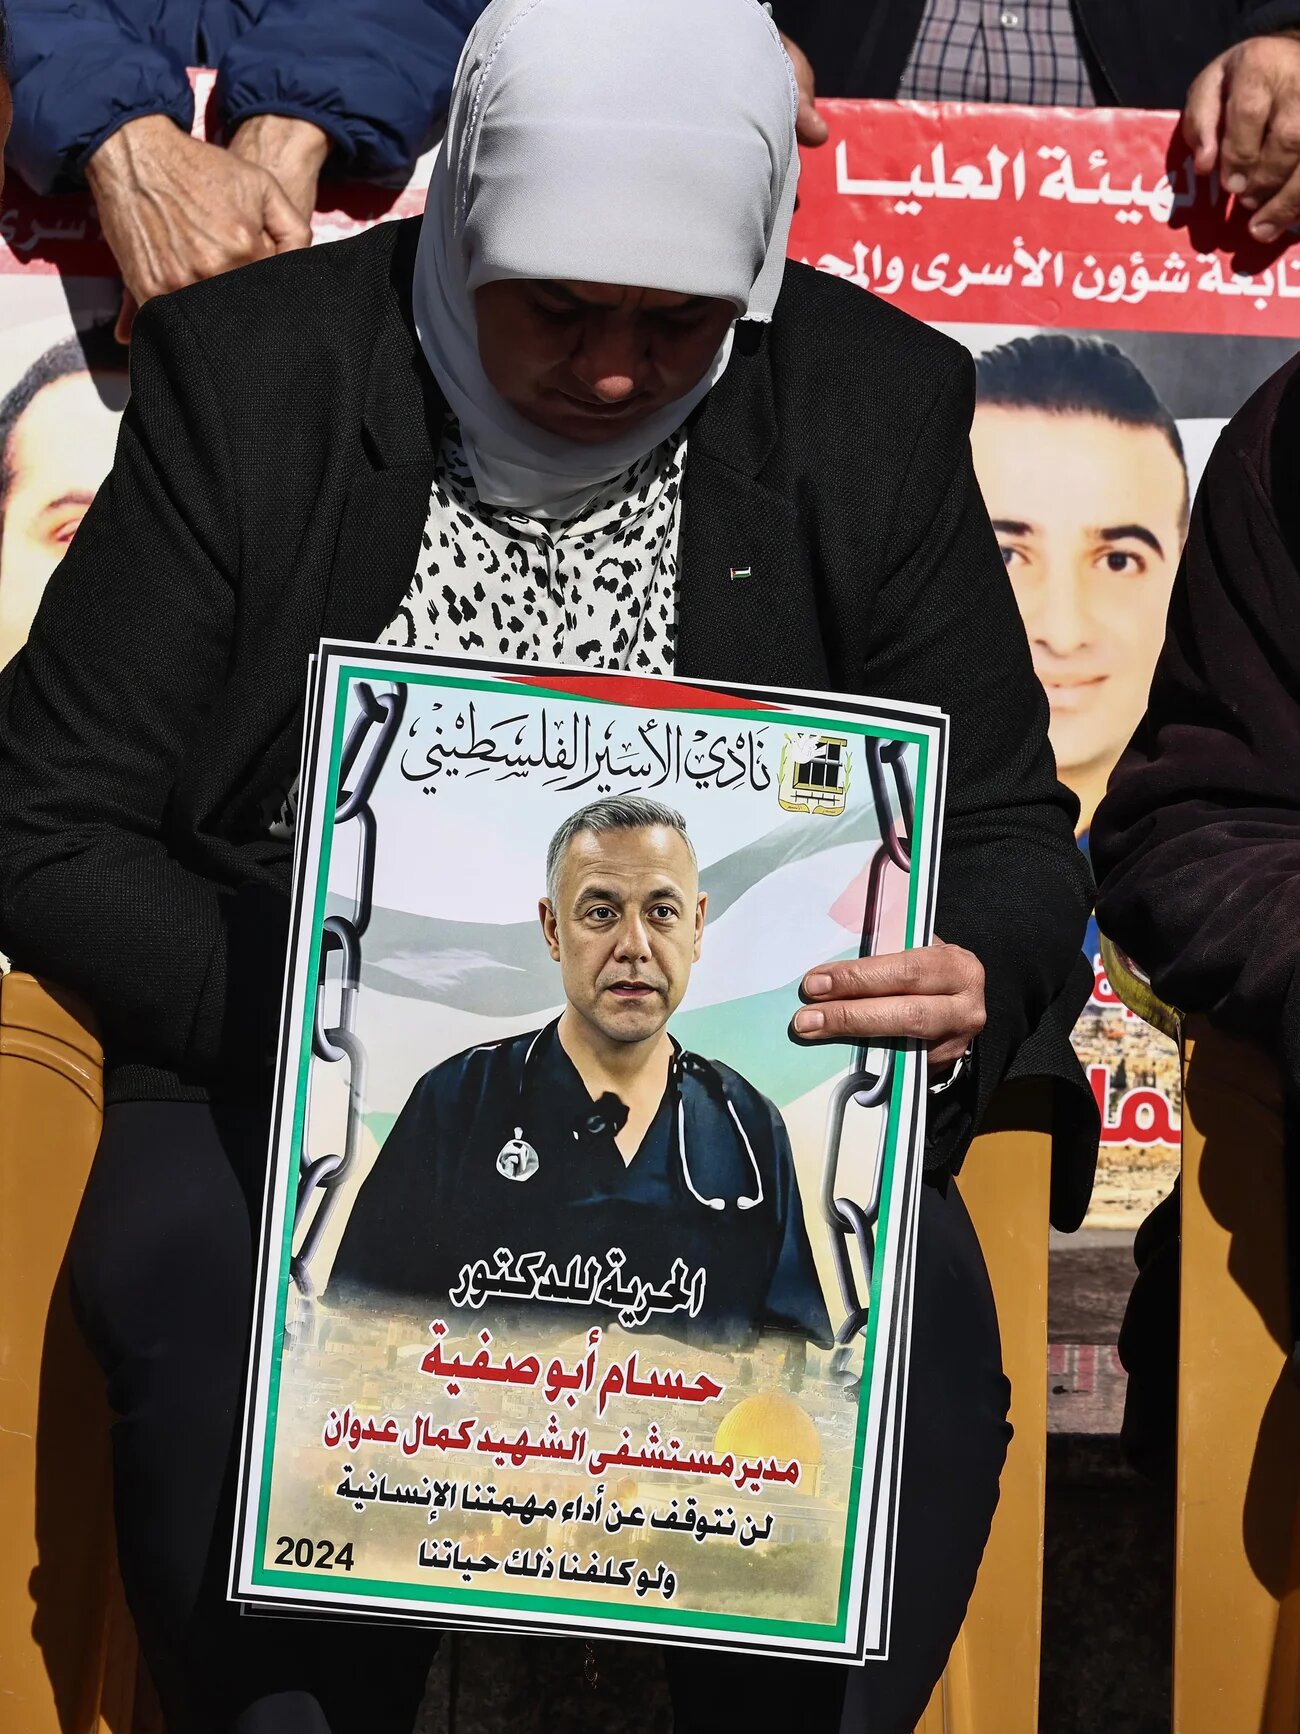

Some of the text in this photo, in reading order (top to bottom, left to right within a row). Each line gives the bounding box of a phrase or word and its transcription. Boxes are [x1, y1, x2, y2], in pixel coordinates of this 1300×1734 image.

[835, 139, 1220, 225] الهيئة العليا
[910, 237, 1064, 297] الأسرى
[1072, 252, 1190, 303] شؤون
[449, 1247, 706, 1327] الحرية للدكتور
[419, 1320, 724, 1417] حسام أبو صفية
[323, 1408, 801, 1493] مدير مستشفى الشهيد كمال عدوان
[335, 1464, 774, 1546] لن نتوقف عن أداء مهمتنا الإنسانية
[274, 1536, 355, 1572] 2024
[418, 1538, 678, 1599] ولو كلفنا ذلك حياتنا
